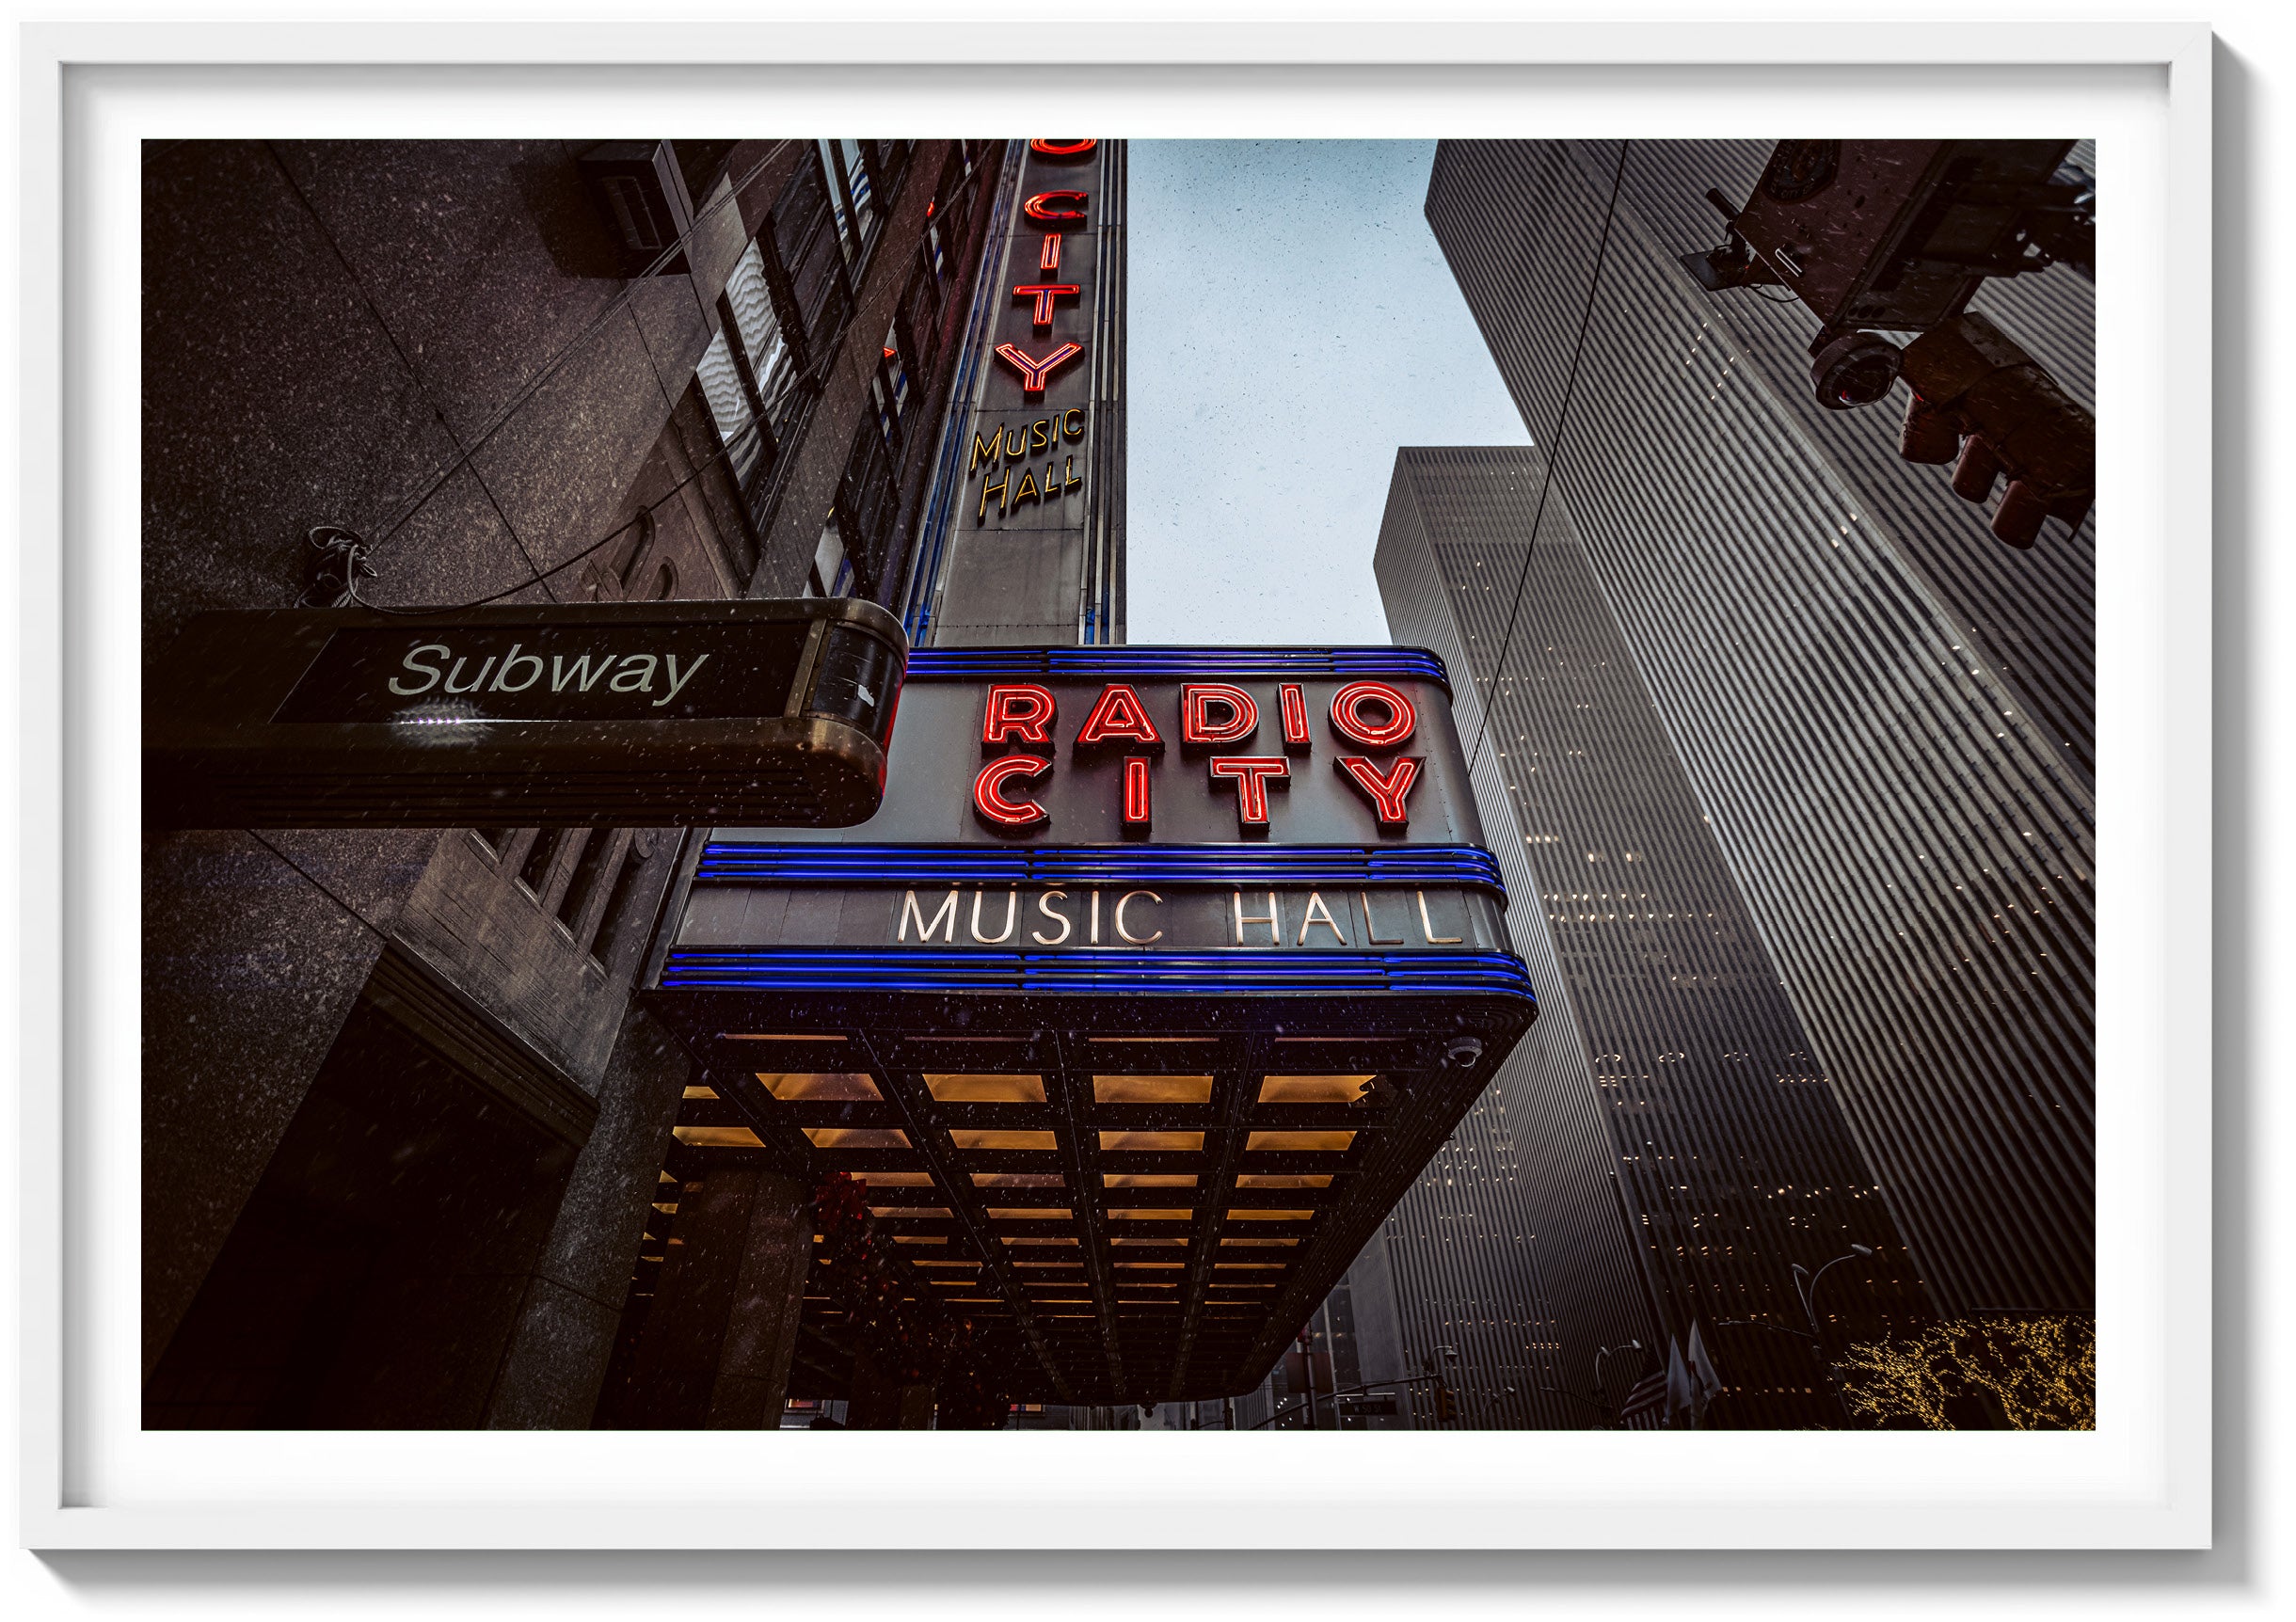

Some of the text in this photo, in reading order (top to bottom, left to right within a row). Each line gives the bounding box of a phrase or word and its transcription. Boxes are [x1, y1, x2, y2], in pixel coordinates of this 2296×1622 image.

[994, 190, 1089, 402] CITY
[971, 408, 1085, 476] MUSIC
[977, 453, 1081, 524] HALL
[388, 644, 710, 707] Subway
[981, 680, 1418, 753] RADIO
[973, 754, 1426, 835] CITY
[897, 890, 1463, 946] MUSIC HALL
